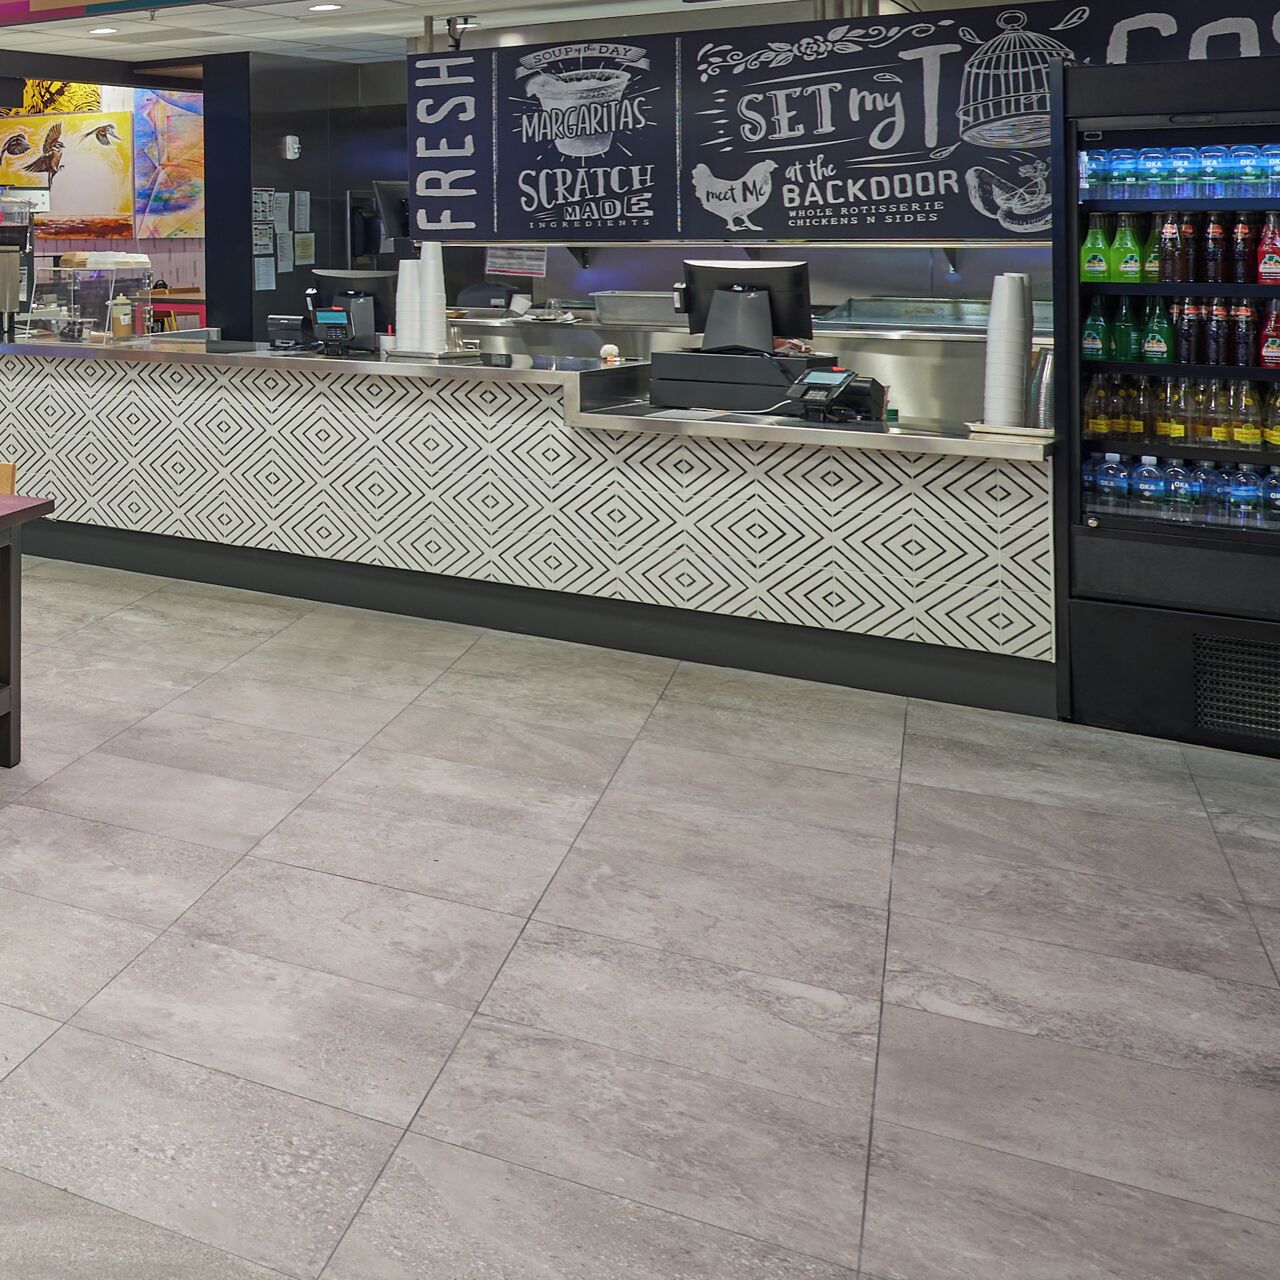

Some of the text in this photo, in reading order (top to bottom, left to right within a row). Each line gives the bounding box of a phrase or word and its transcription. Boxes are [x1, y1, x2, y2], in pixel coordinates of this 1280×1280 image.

[533, 47, 573, 64] SOUP
[583, 44, 596, 53] the
[598, 45, 632, 57] DAY
[737, 44, 962, 150] SET my T
[416, 57, 476, 231] FRESH
[784, 154, 837, 183] at the
[518, 165, 655, 212] SCRATCH
[705, 183, 737, 204] meet
[782, 169, 960, 208] BACKDOOR
[563, 192, 654, 221] MADE
[788, 213, 939, 227] CHICKENS N SIDES
[789, 201, 945, 218] WHOLE ROTISSERIE
[529, 218, 651, 229] INGREDIENTS
